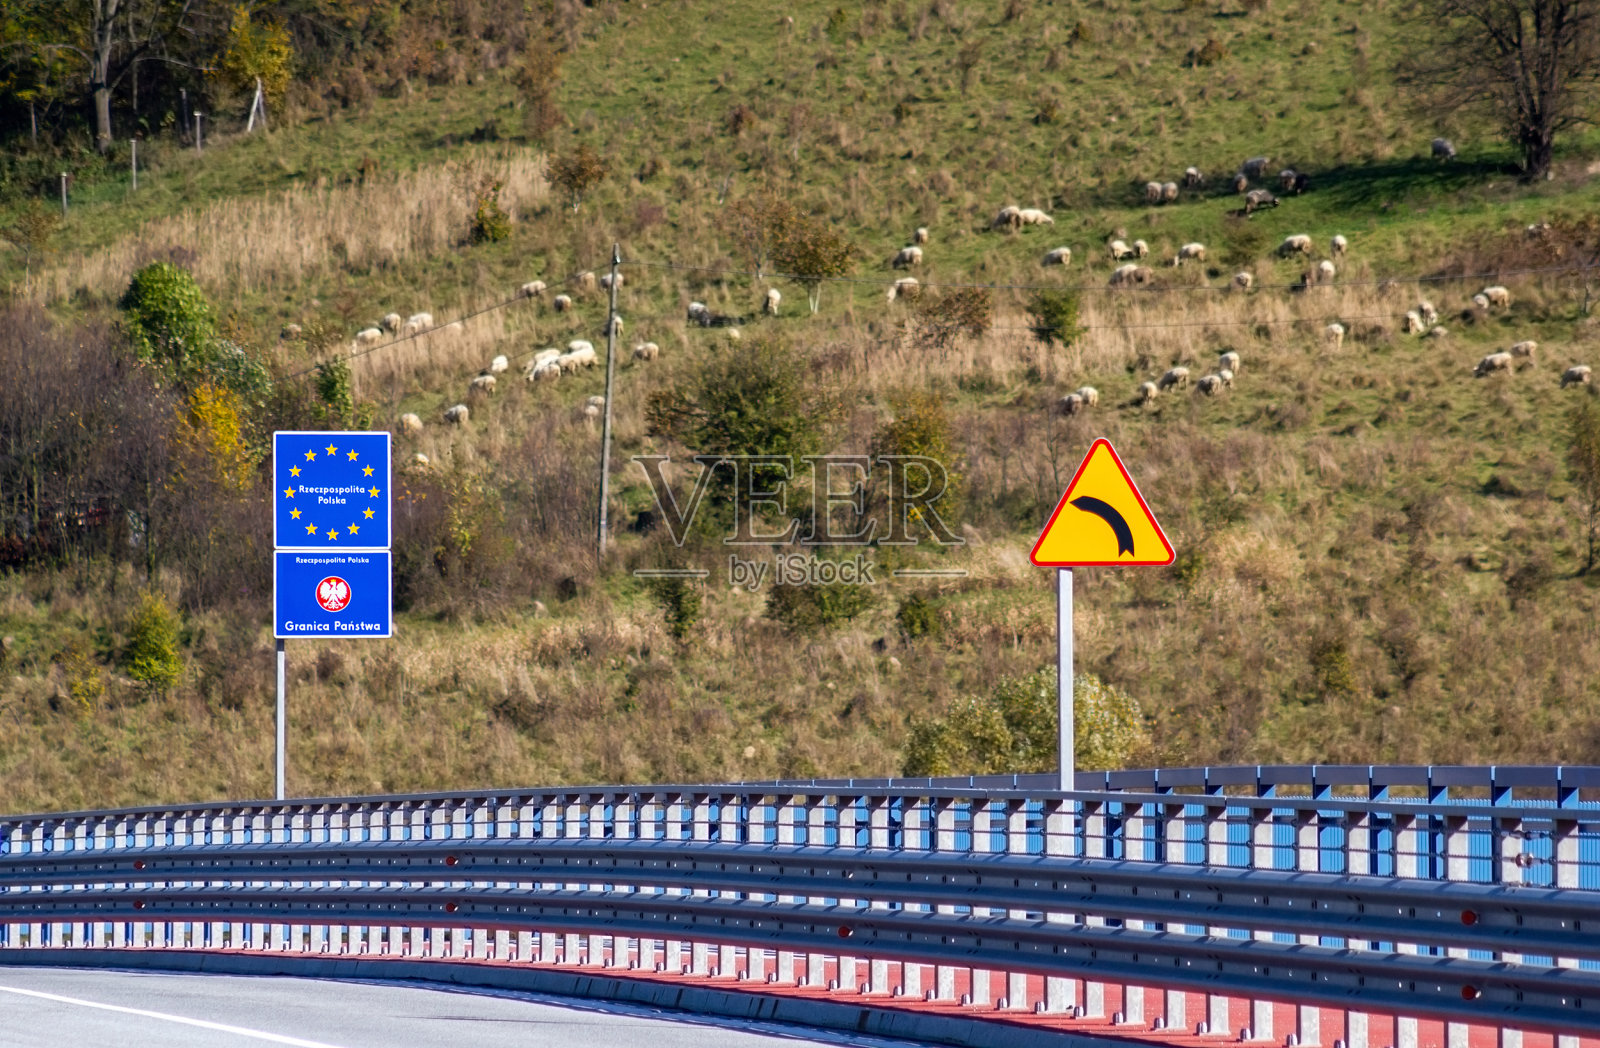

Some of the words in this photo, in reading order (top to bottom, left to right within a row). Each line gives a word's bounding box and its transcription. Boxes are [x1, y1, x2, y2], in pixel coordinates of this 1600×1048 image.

[299, 485, 365, 495] Rzeczpospolita
[318, 496, 346, 504] Polska
[296, 557, 346, 565] Rzeczpospolita
[285, 621, 330, 631] Granica
[334, 621, 381, 631] Państwa
